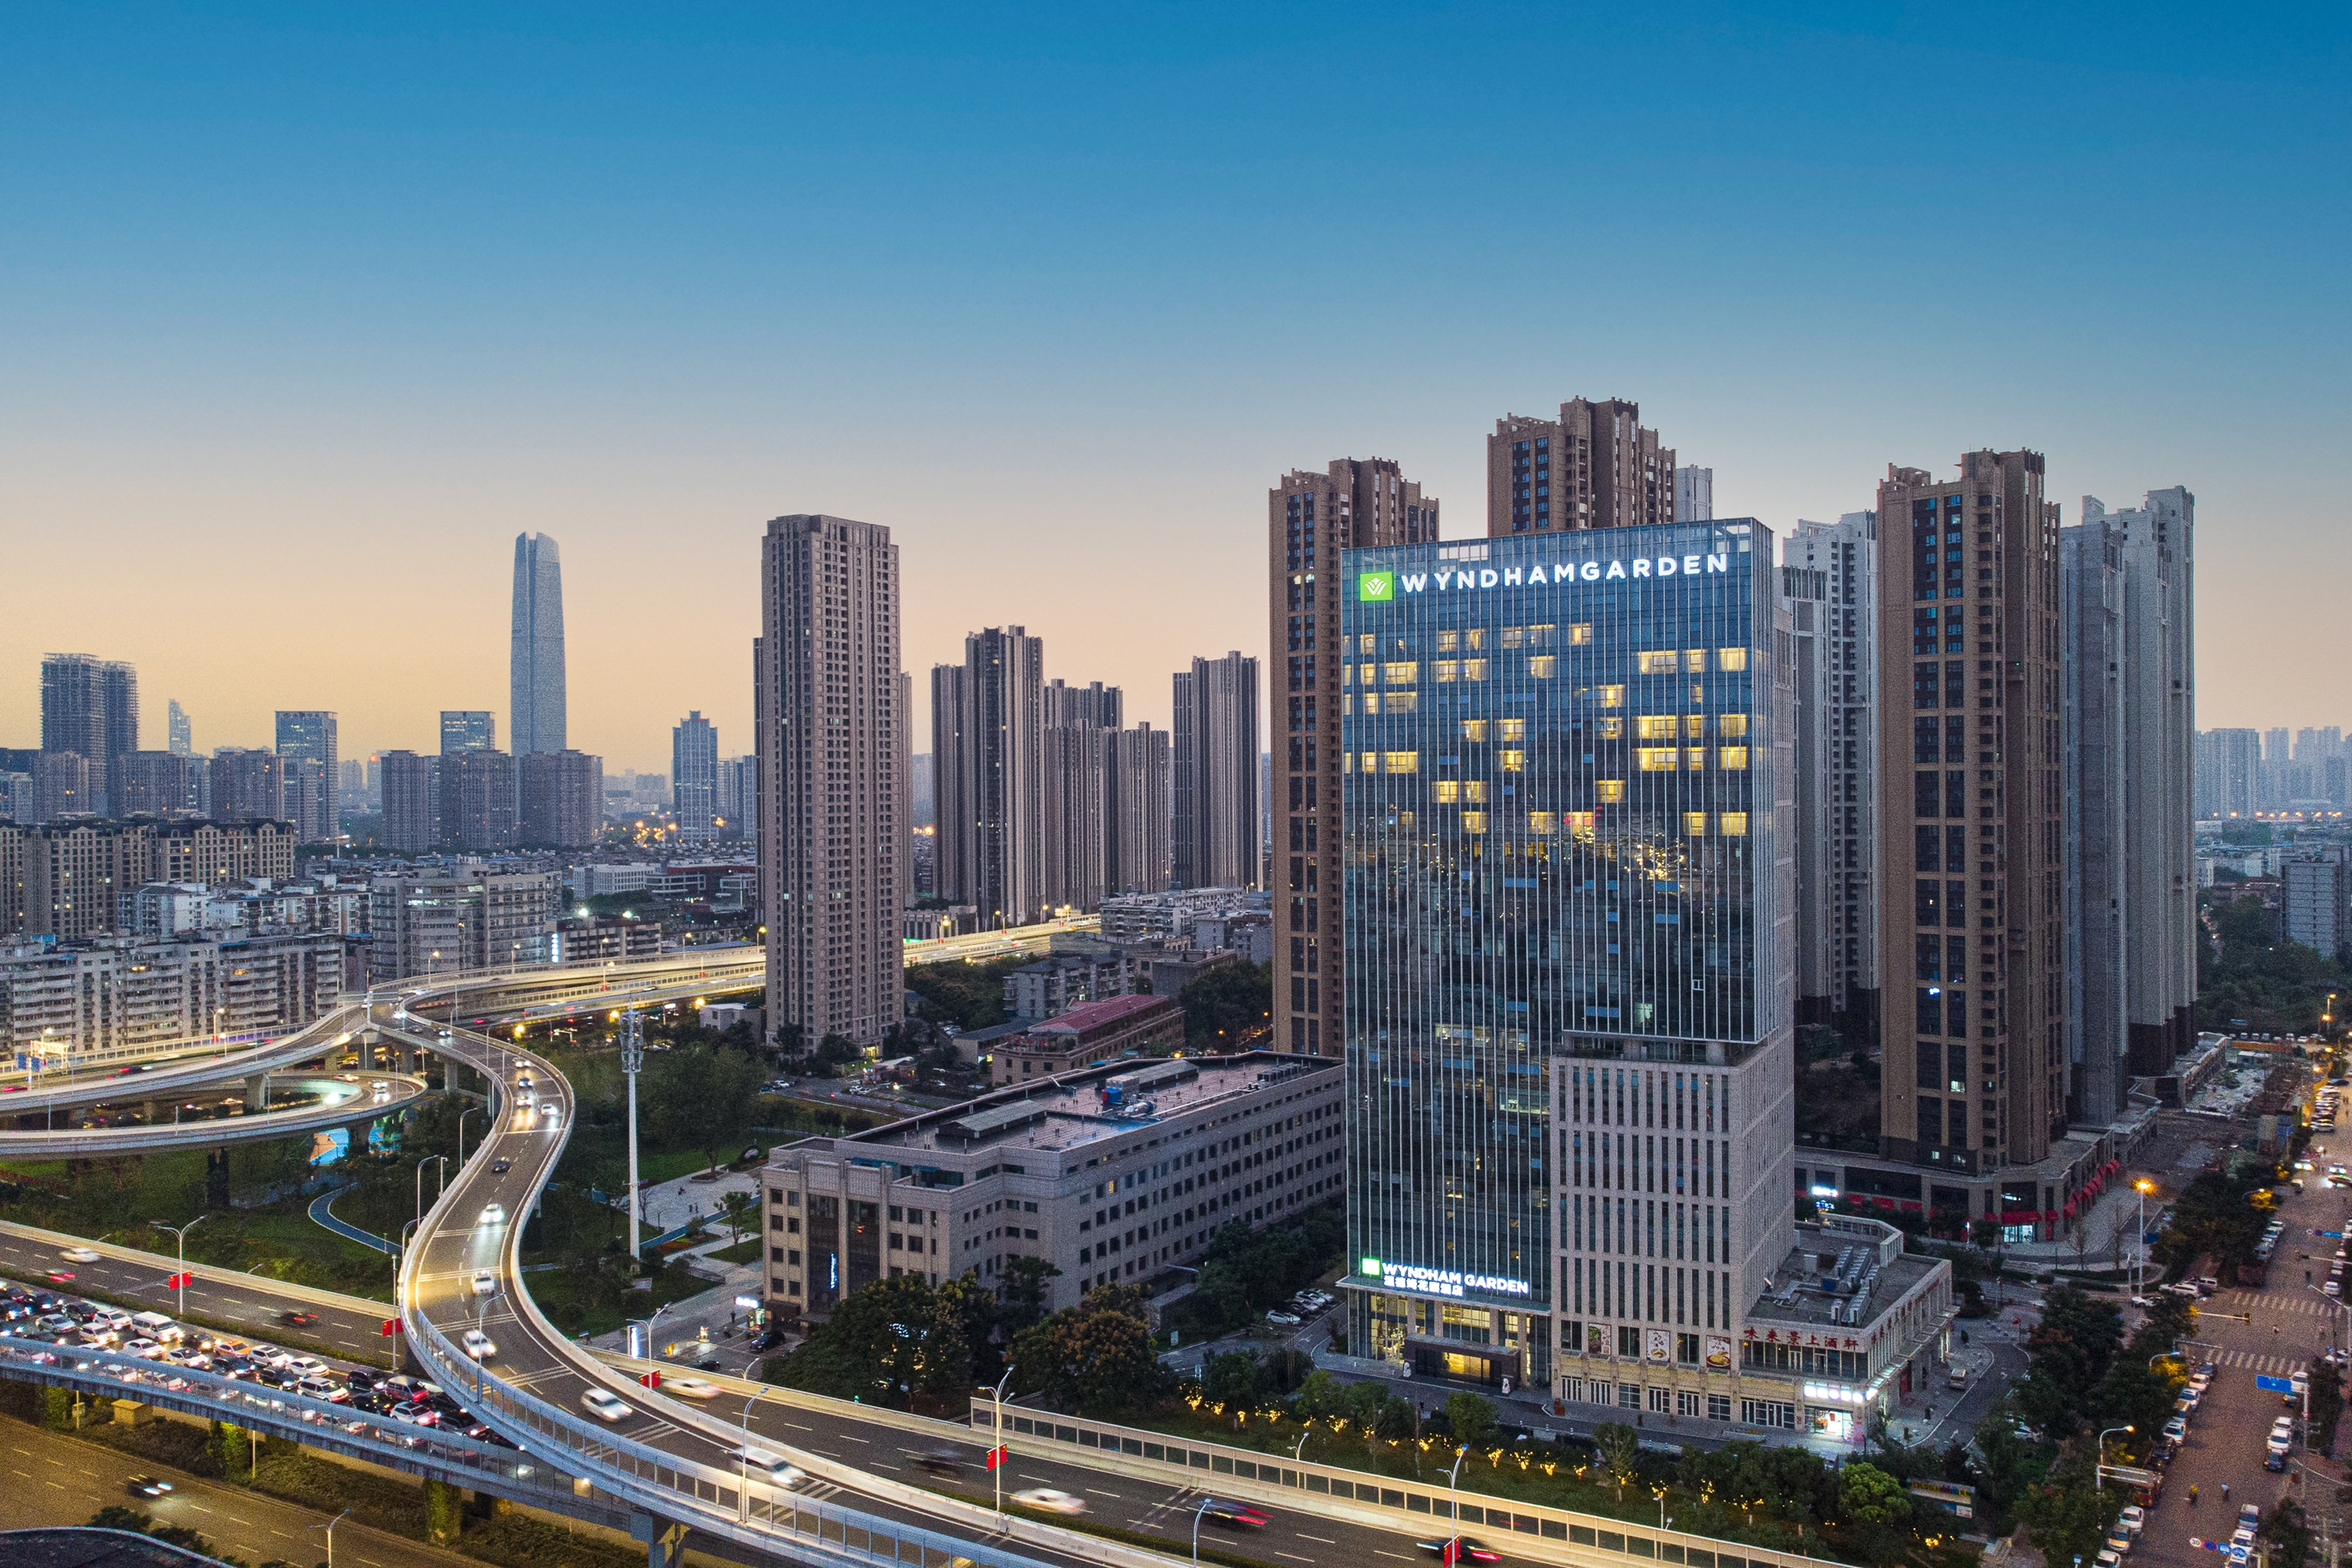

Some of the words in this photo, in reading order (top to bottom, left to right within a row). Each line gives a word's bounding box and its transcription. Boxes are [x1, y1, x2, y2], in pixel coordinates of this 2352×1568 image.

[1401, 554, 1728, 593] WYNDHAMGARDEN
[1382, 1263, 1461, 1284] WYNDHAM
[1465, 1274, 1528, 1294] GARDEN
